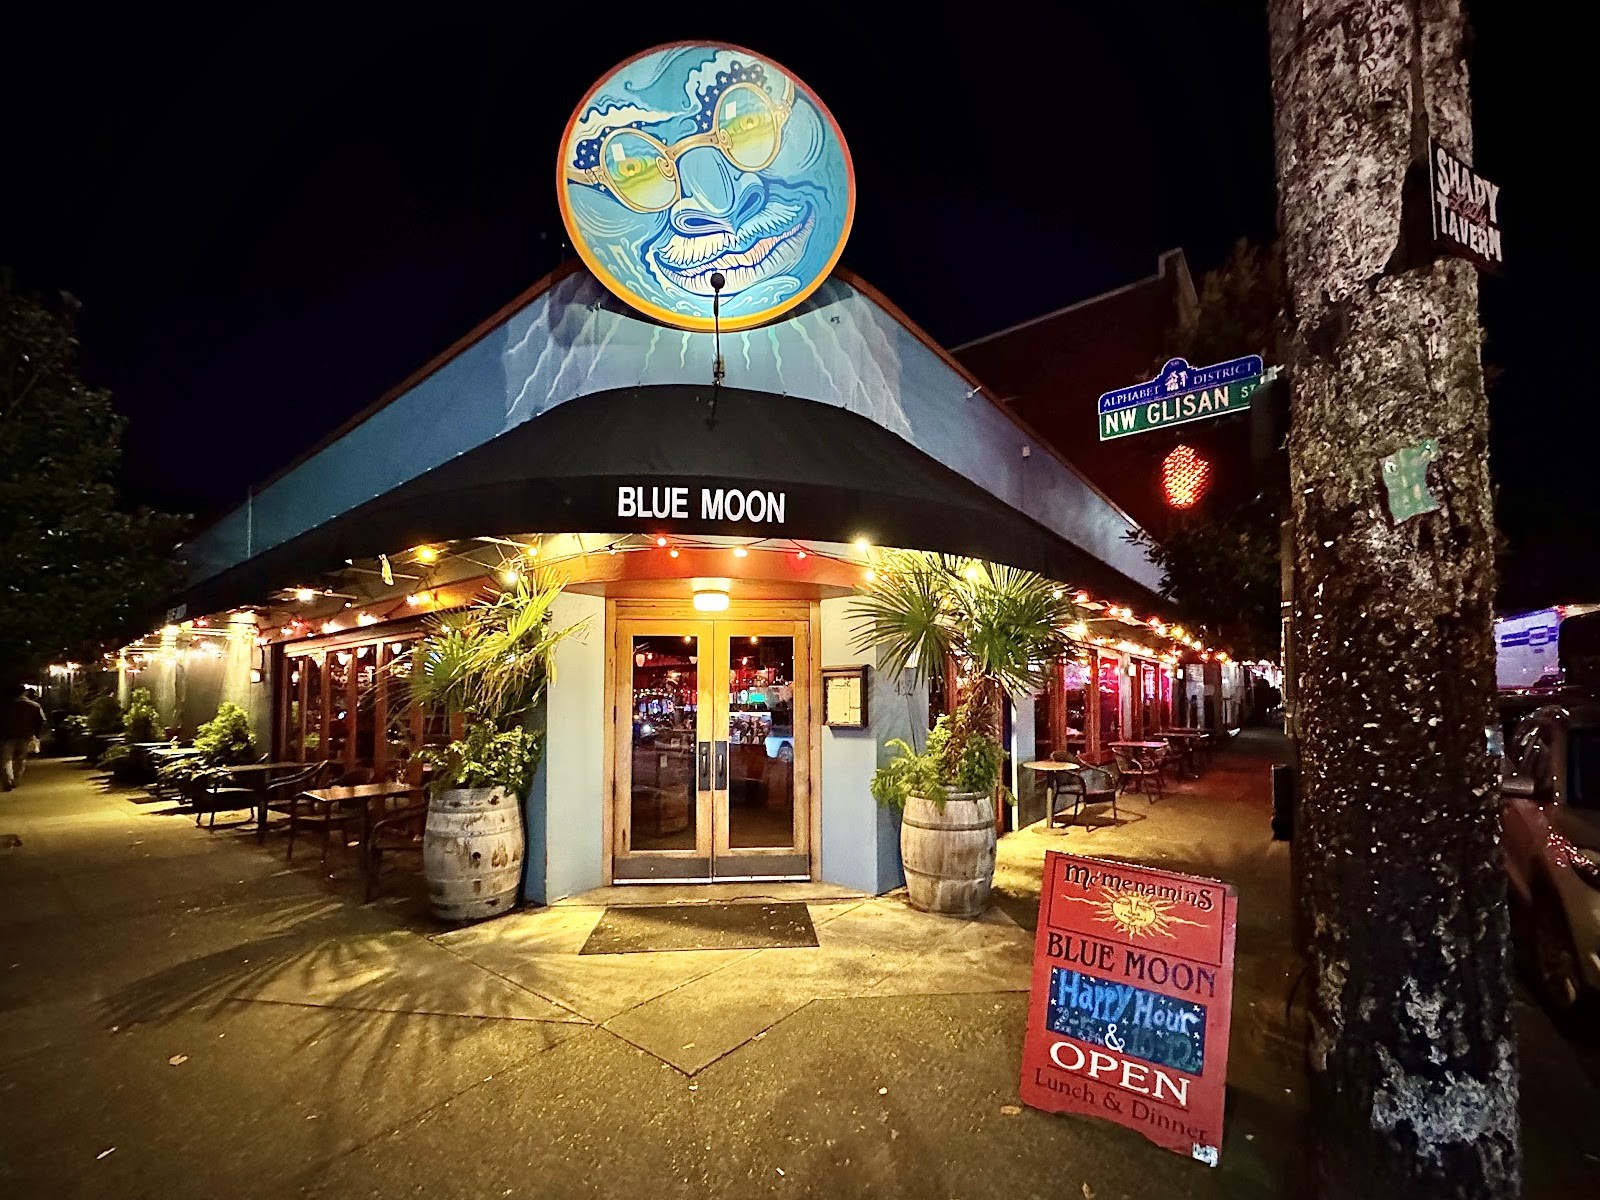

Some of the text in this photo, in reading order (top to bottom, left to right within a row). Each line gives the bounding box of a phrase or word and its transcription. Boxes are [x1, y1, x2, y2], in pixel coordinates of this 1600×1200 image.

[1437, 147, 1500, 224] SHADY
[1436, 190, 1502, 263] TAVERN
[1103, 384, 1161, 408] ALPHABET
[1193, 361, 1254, 386] DISTRICT
[1105, 407, 1137, 434] NW
[1147, 385, 1230, 425] GLISAN
[617, 486, 786, 524] BLUE MOON
[1046, 931, 1217, 998] BLUE MOON
[1058, 968, 1201, 1035] Happy Hour
[1104, 1023, 1126, 1053] &
[1035, 1067, 1208, 1142] Lunch & Dinner
[1049, 1041, 1191, 1107] OPEN
